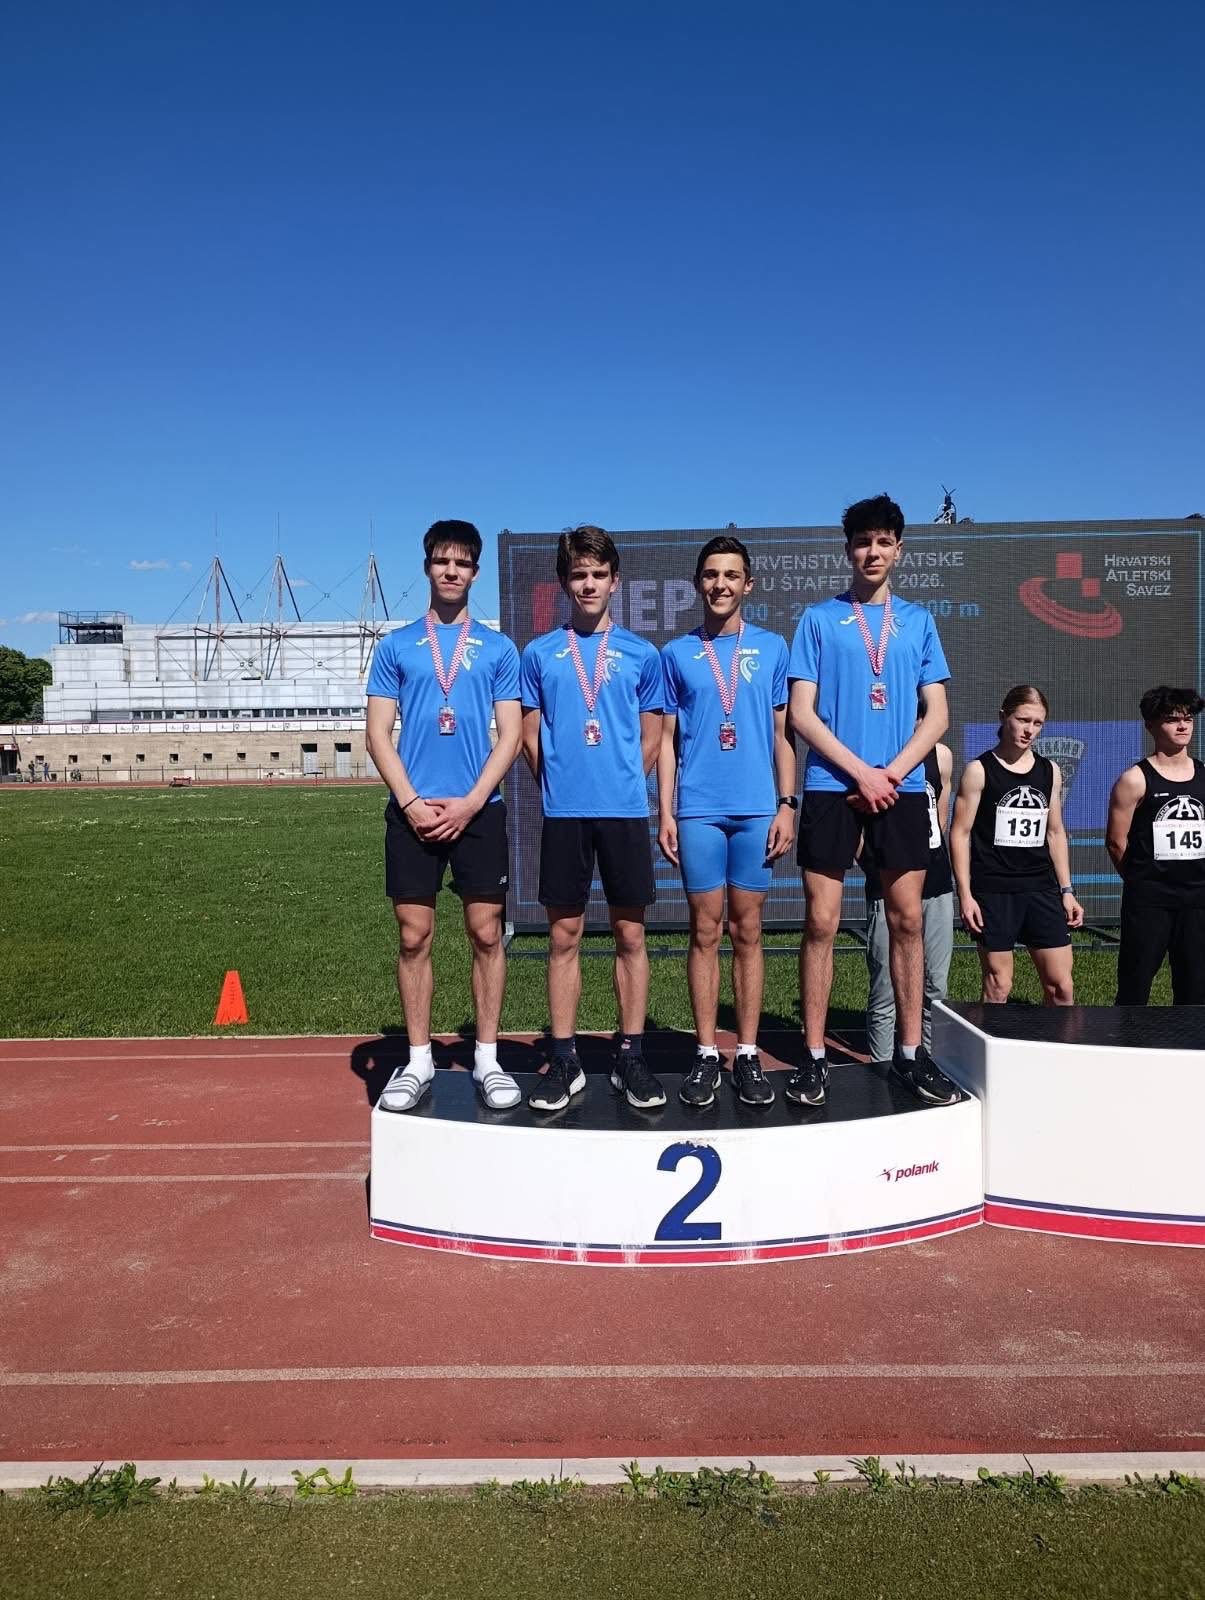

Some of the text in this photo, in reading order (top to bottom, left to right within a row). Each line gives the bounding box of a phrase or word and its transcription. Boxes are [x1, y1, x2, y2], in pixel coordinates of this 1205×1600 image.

[1104, 553, 1171, 567] HRVATSKI
[762, 577, 775, 591] U
[898, 573, 945, 588] 2026.
[1105, 568, 1171, 582] ATLETSKI
[1126, 583, 1171, 597] SAVEZ
[1008, 818, 1041, 837] 131
[1166, 830, 1203, 850] 145
[895, 1160, 940, 1183] polanik
[654, 1141, 722, 1241] 2
